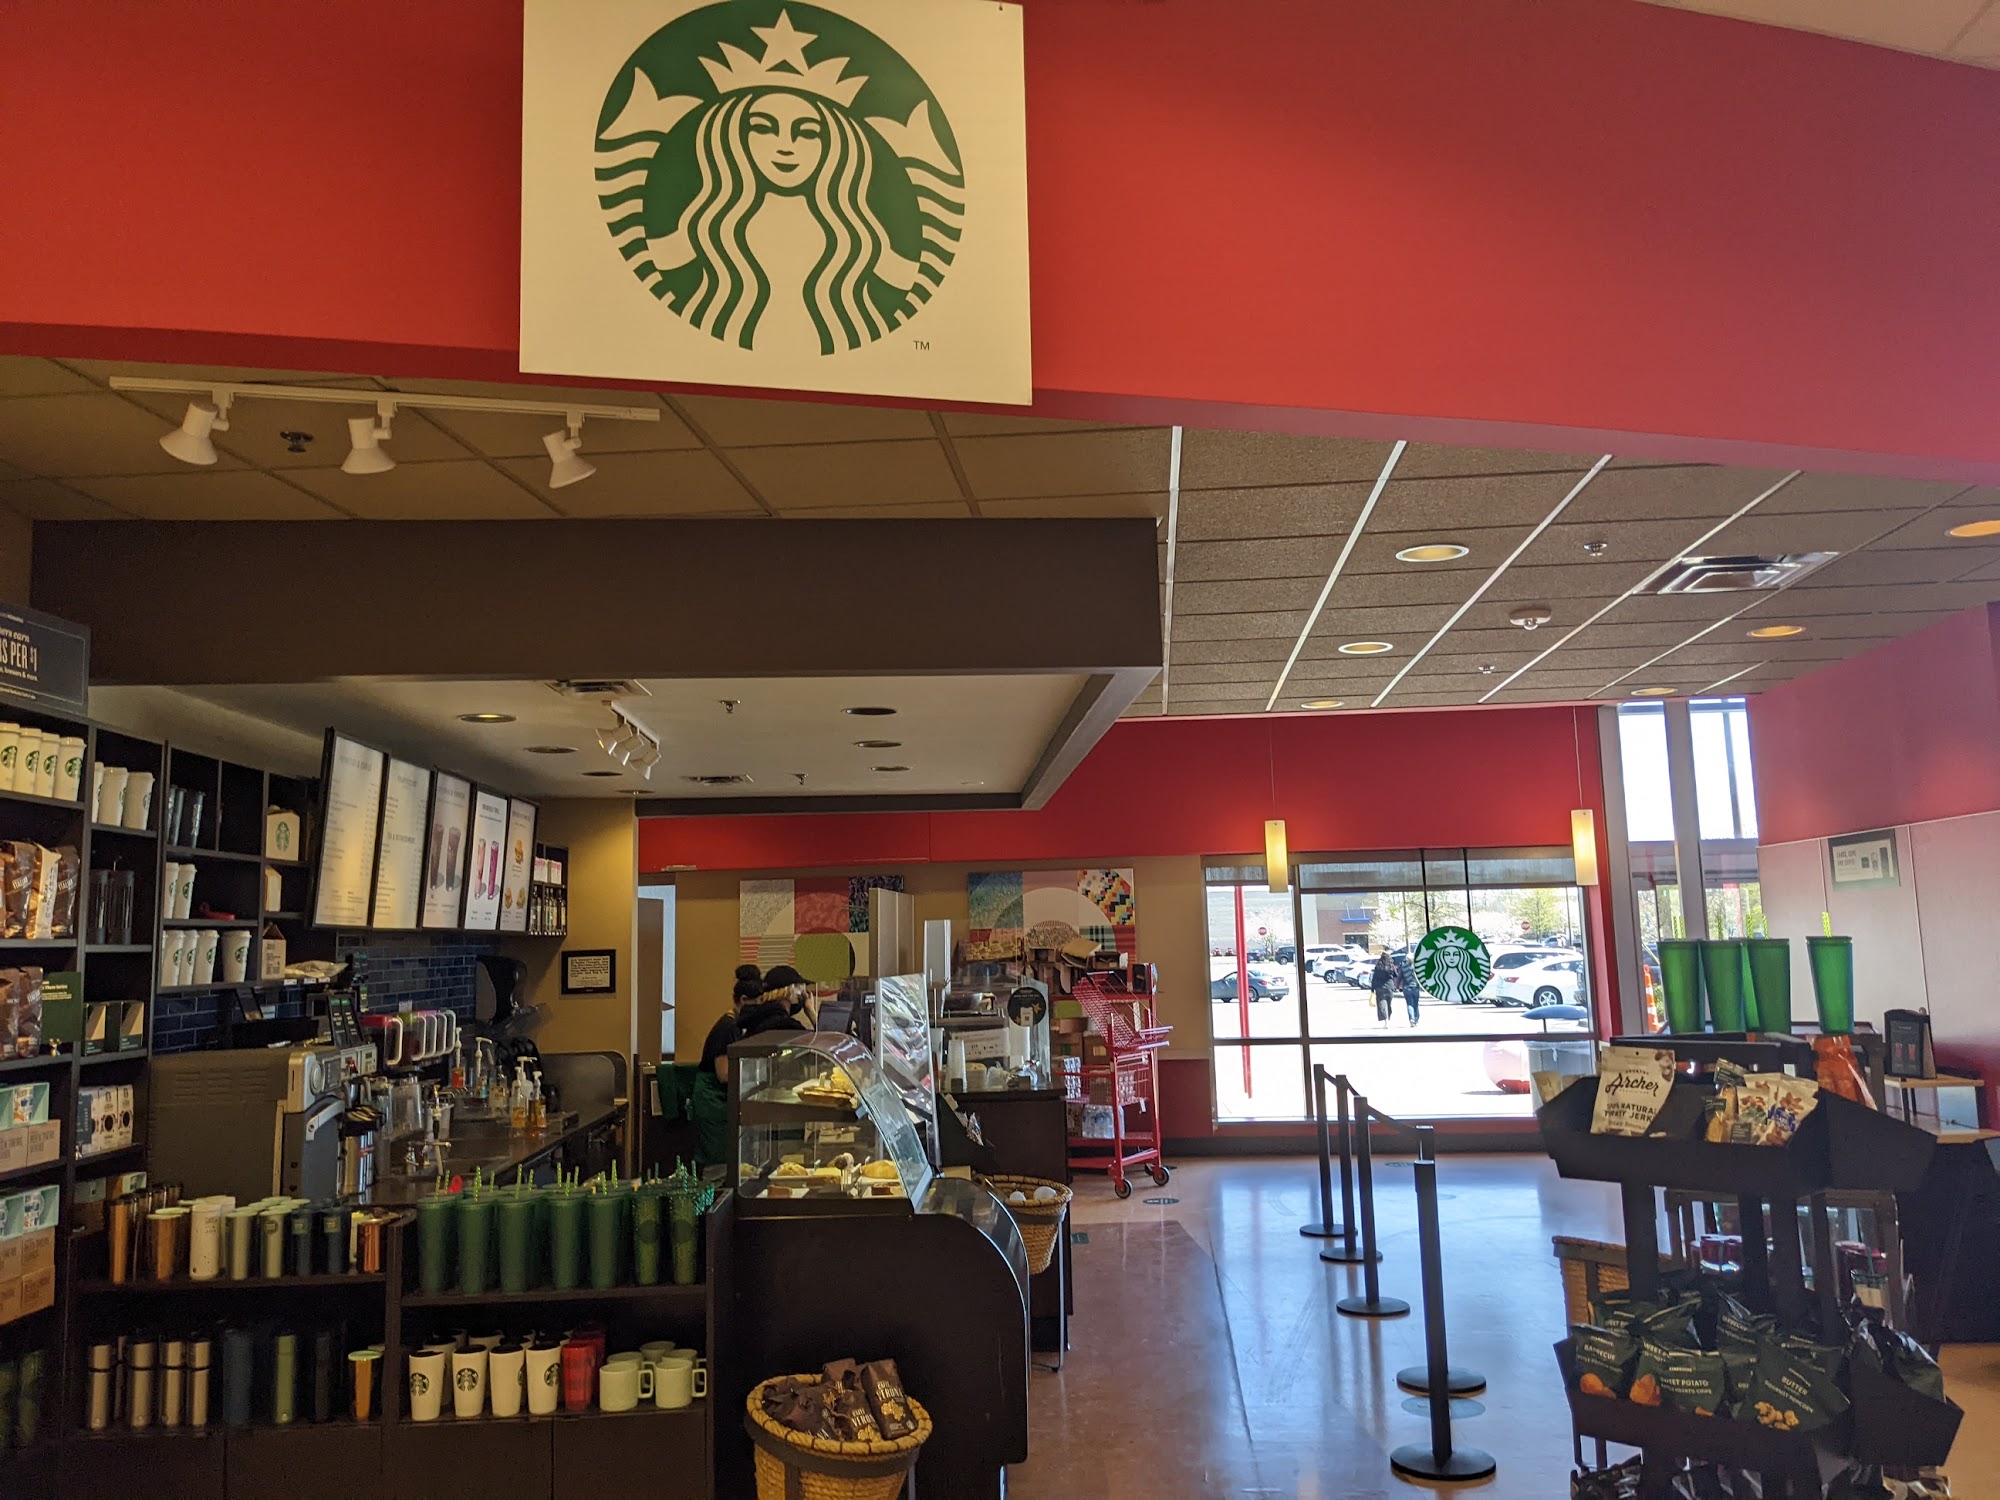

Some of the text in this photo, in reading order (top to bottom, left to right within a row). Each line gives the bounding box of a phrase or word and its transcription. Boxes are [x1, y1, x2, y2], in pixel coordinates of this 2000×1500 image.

[912, 340, 930, 351] TM
[10, 641, 28, 670] PER
[1605, 1072, 1659, 1097] Archer
[1629, 1112, 1653, 1123] JERK
[1782, 1375, 1808, 1396] BUTTER
